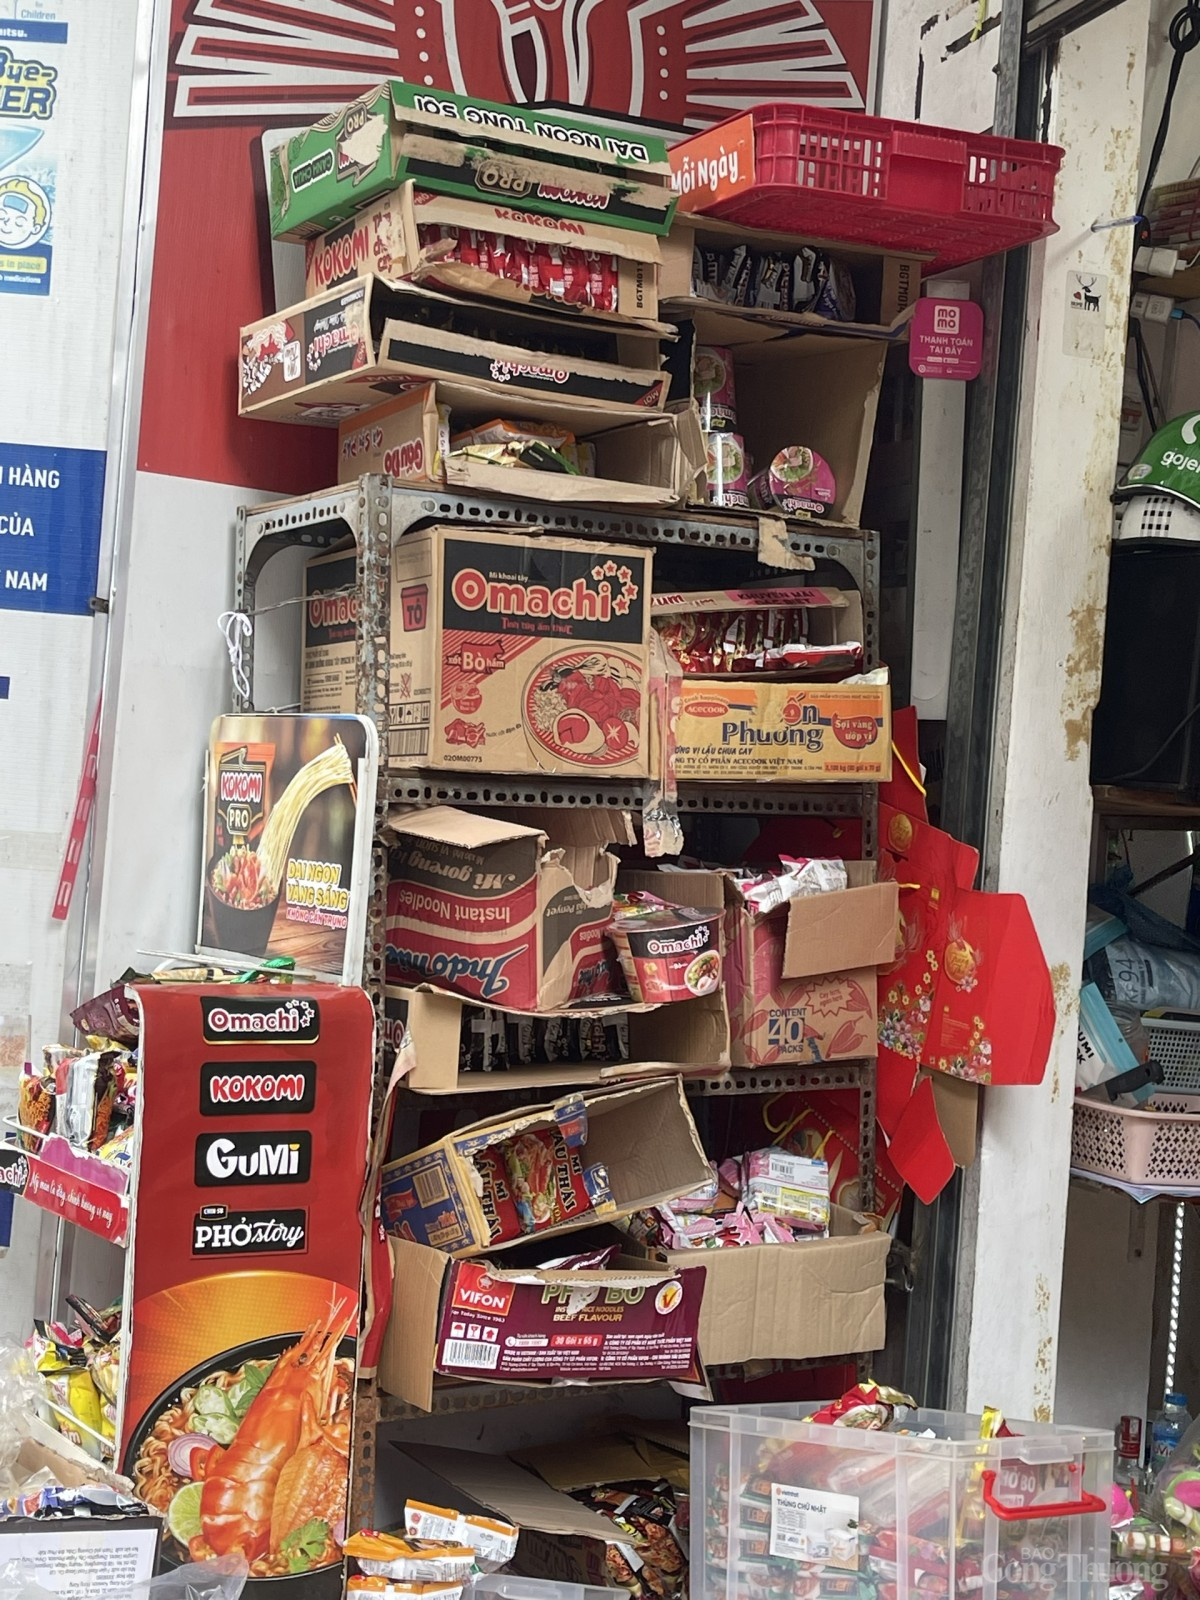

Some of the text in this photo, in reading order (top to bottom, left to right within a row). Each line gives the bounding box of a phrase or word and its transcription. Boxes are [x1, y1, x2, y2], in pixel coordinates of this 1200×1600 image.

[21, 9, 56, 20] Children
[697, 145, 739, 192] Ngày
[315, 226, 369, 288] KOKOMI
[920, 335, 973, 347] THANH TOÁN
[9, 464, 60, 489] HÀNG
[0, 512, 34, 537] CỦA
[5, 570, 48, 592] NAM
[451, 568, 612, 622] Omachi
[309, 590, 357, 628] Omac
[463, 651, 485, 670] Bò
[722, 719, 824, 753] Phương
[834, 719, 873, 731] Sợi vàng
[738, 747, 753, 756] CAY
[221, 771, 262, 804] KOKOMI
[229, 809, 249, 829] PRO
[287, 859, 341, 886] DAI NGON
[287, 879, 315, 906] VÀNG
[399, 888, 511, 924] Noodles Instant
[647, 932, 704, 955] Omachi
[208, 1008, 299, 1033] Omachi
[769, 1007, 806, 1018] CONTENT
[768, 1017, 804, 1046] 40
[777, 1044, 804, 1055] PACKS
[210, 1074, 305, 1104] KOKOMI
[557, 1164, 576, 1213] THÁI
[460, 1288, 506, 1308] VIFON
[553, 1314, 623, 1322] BEEF FLAVOUR
[1020, 1471, 1037, 1493] BÒ
